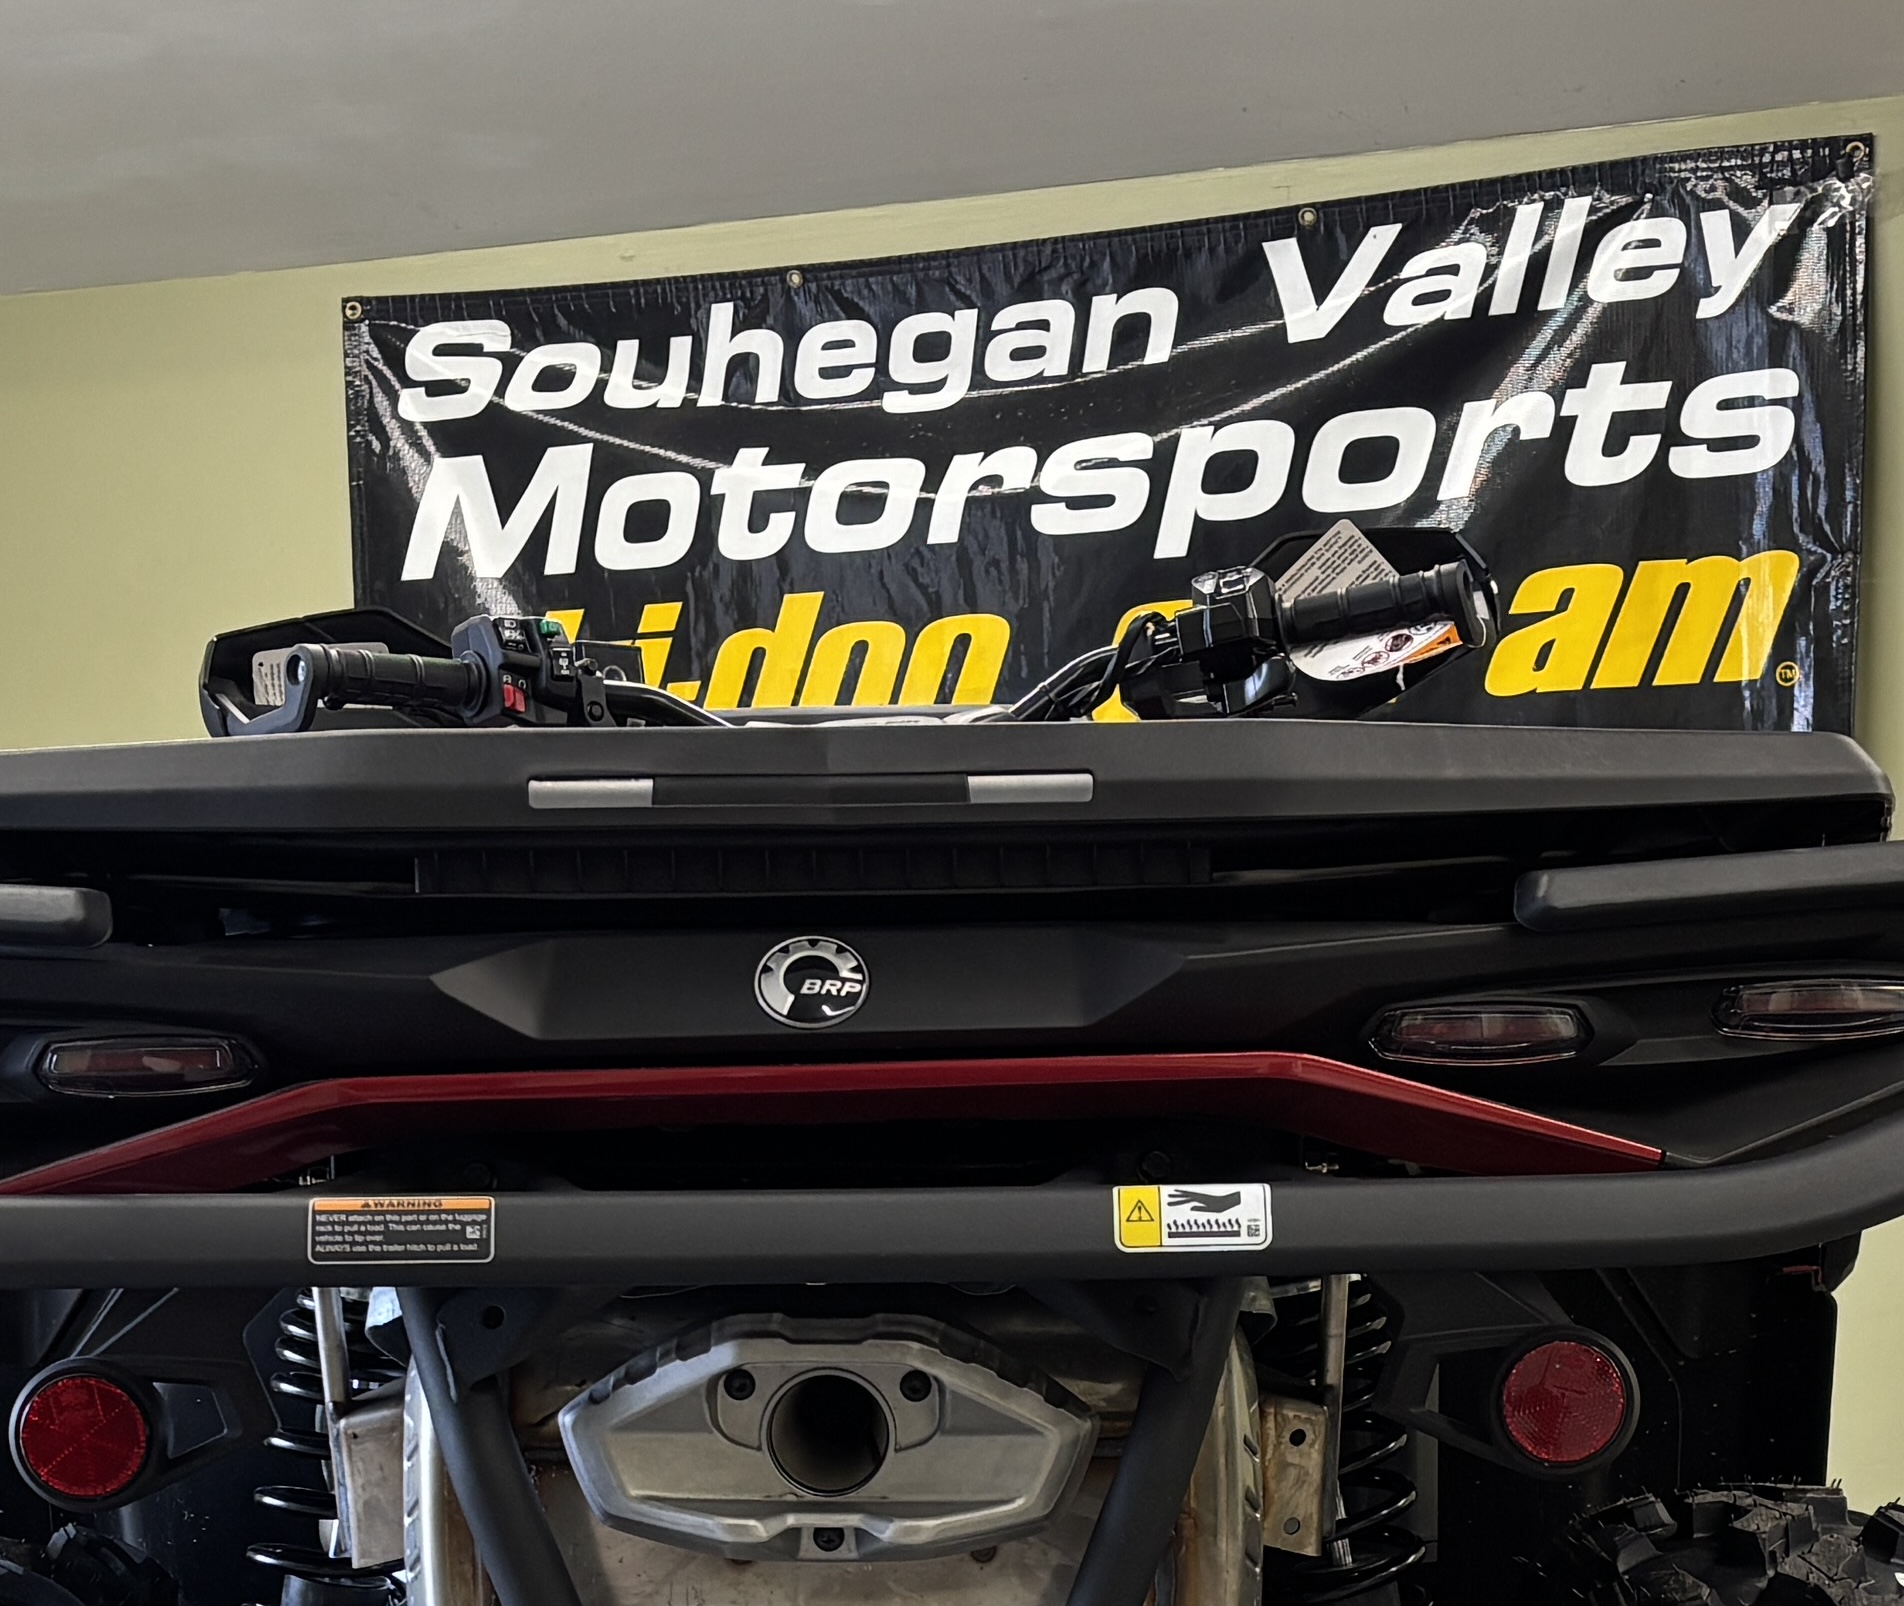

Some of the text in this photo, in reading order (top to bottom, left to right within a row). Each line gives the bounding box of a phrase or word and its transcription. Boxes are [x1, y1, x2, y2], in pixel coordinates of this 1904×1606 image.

[397, 196, 1803, 422] Souhegan Valley
[401, 361, 1800, 581] Motorsports
[545, 592, 1011, 710] i-doo
[800, 979, 862, 997] BRP
[316, 1214, 346, 1222] NEVER
[373, 1200, 442, 1209] WARNING
